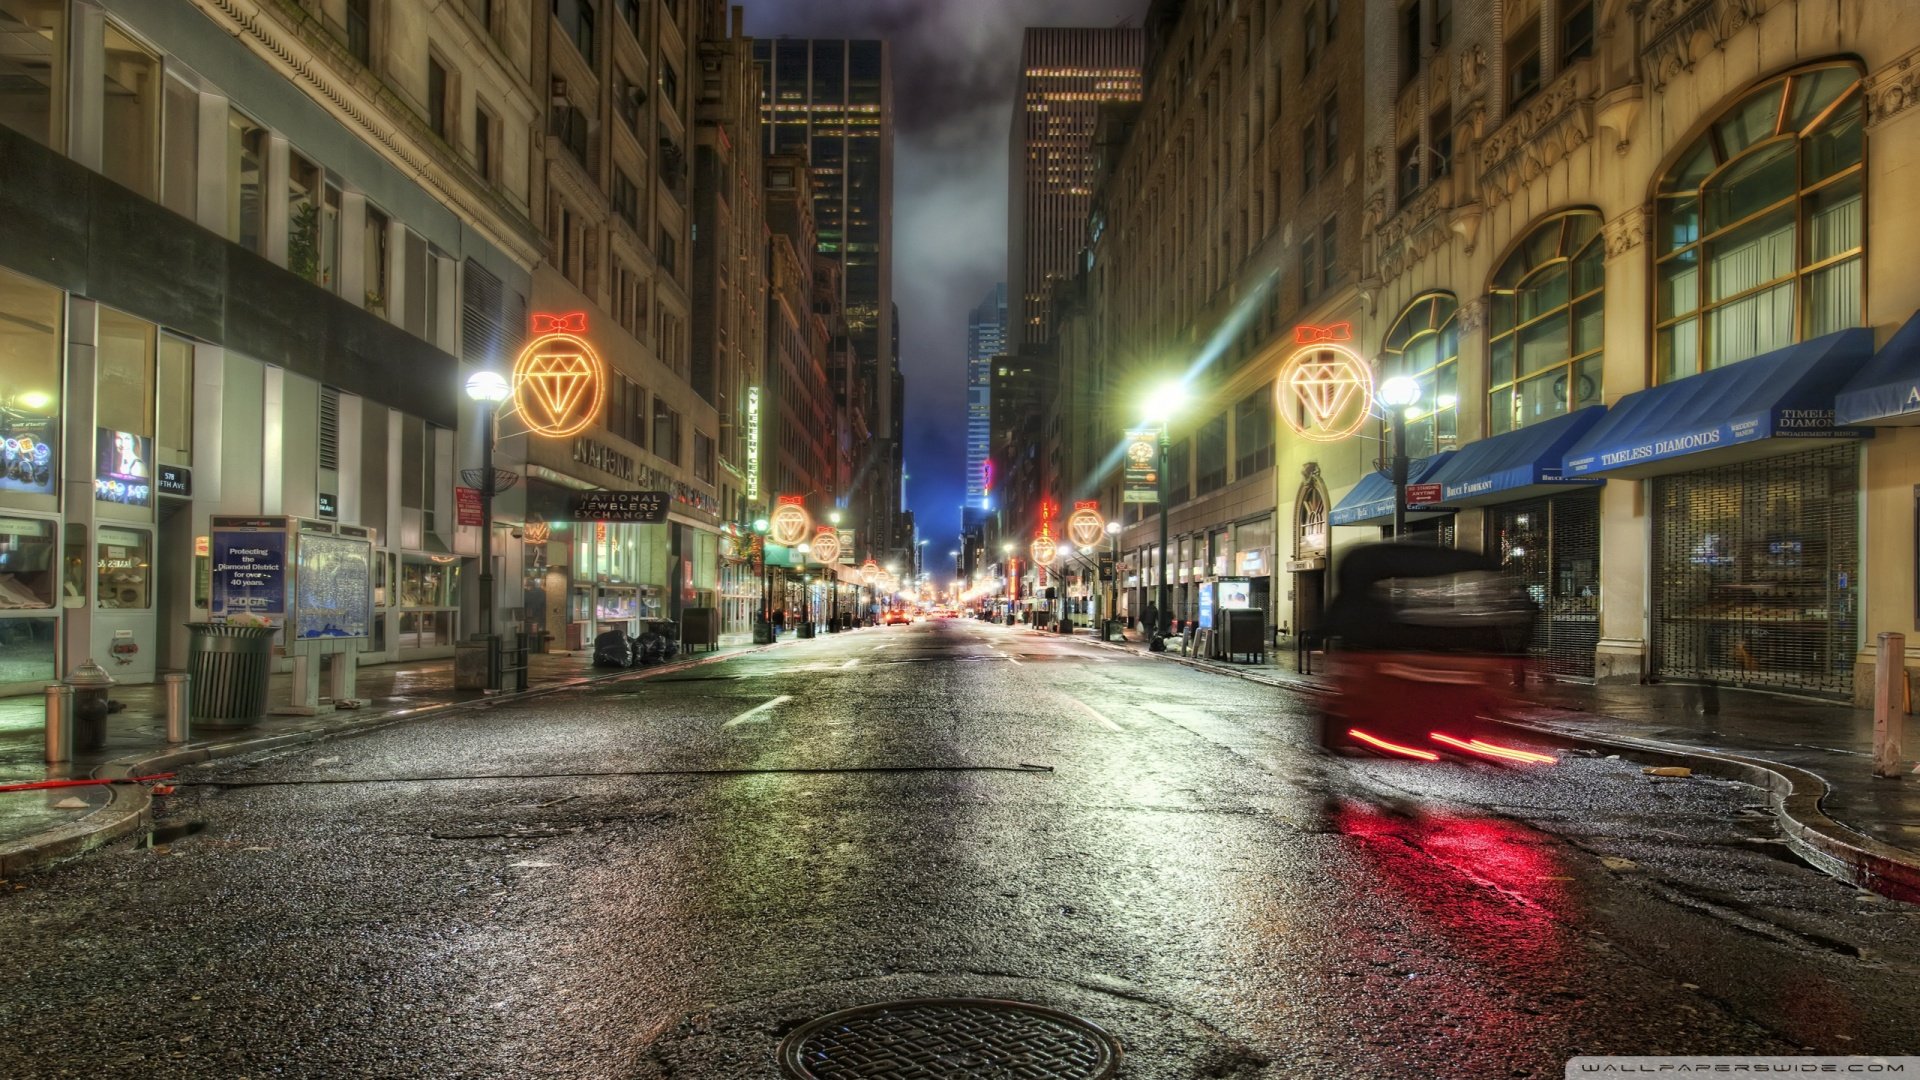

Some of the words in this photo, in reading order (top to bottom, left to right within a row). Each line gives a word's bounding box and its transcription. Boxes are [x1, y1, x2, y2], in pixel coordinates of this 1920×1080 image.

[1781, 409, 1835, 418] TIMELE
[1780, 418, 1835, 428] DIAMON
[1602, 445, 1653, 466] TIMELESS
[1655, 430, 1720, 455] DIAMONDS
[576, 438, 635, 482] NATIONA
[581, 493, 661, 503] NATIONAL
[580, 501, 659, 511] JEWELERS
[574, 510, 654, 520] EXCHANGE
[218, 563, 251, 571] Diamond
